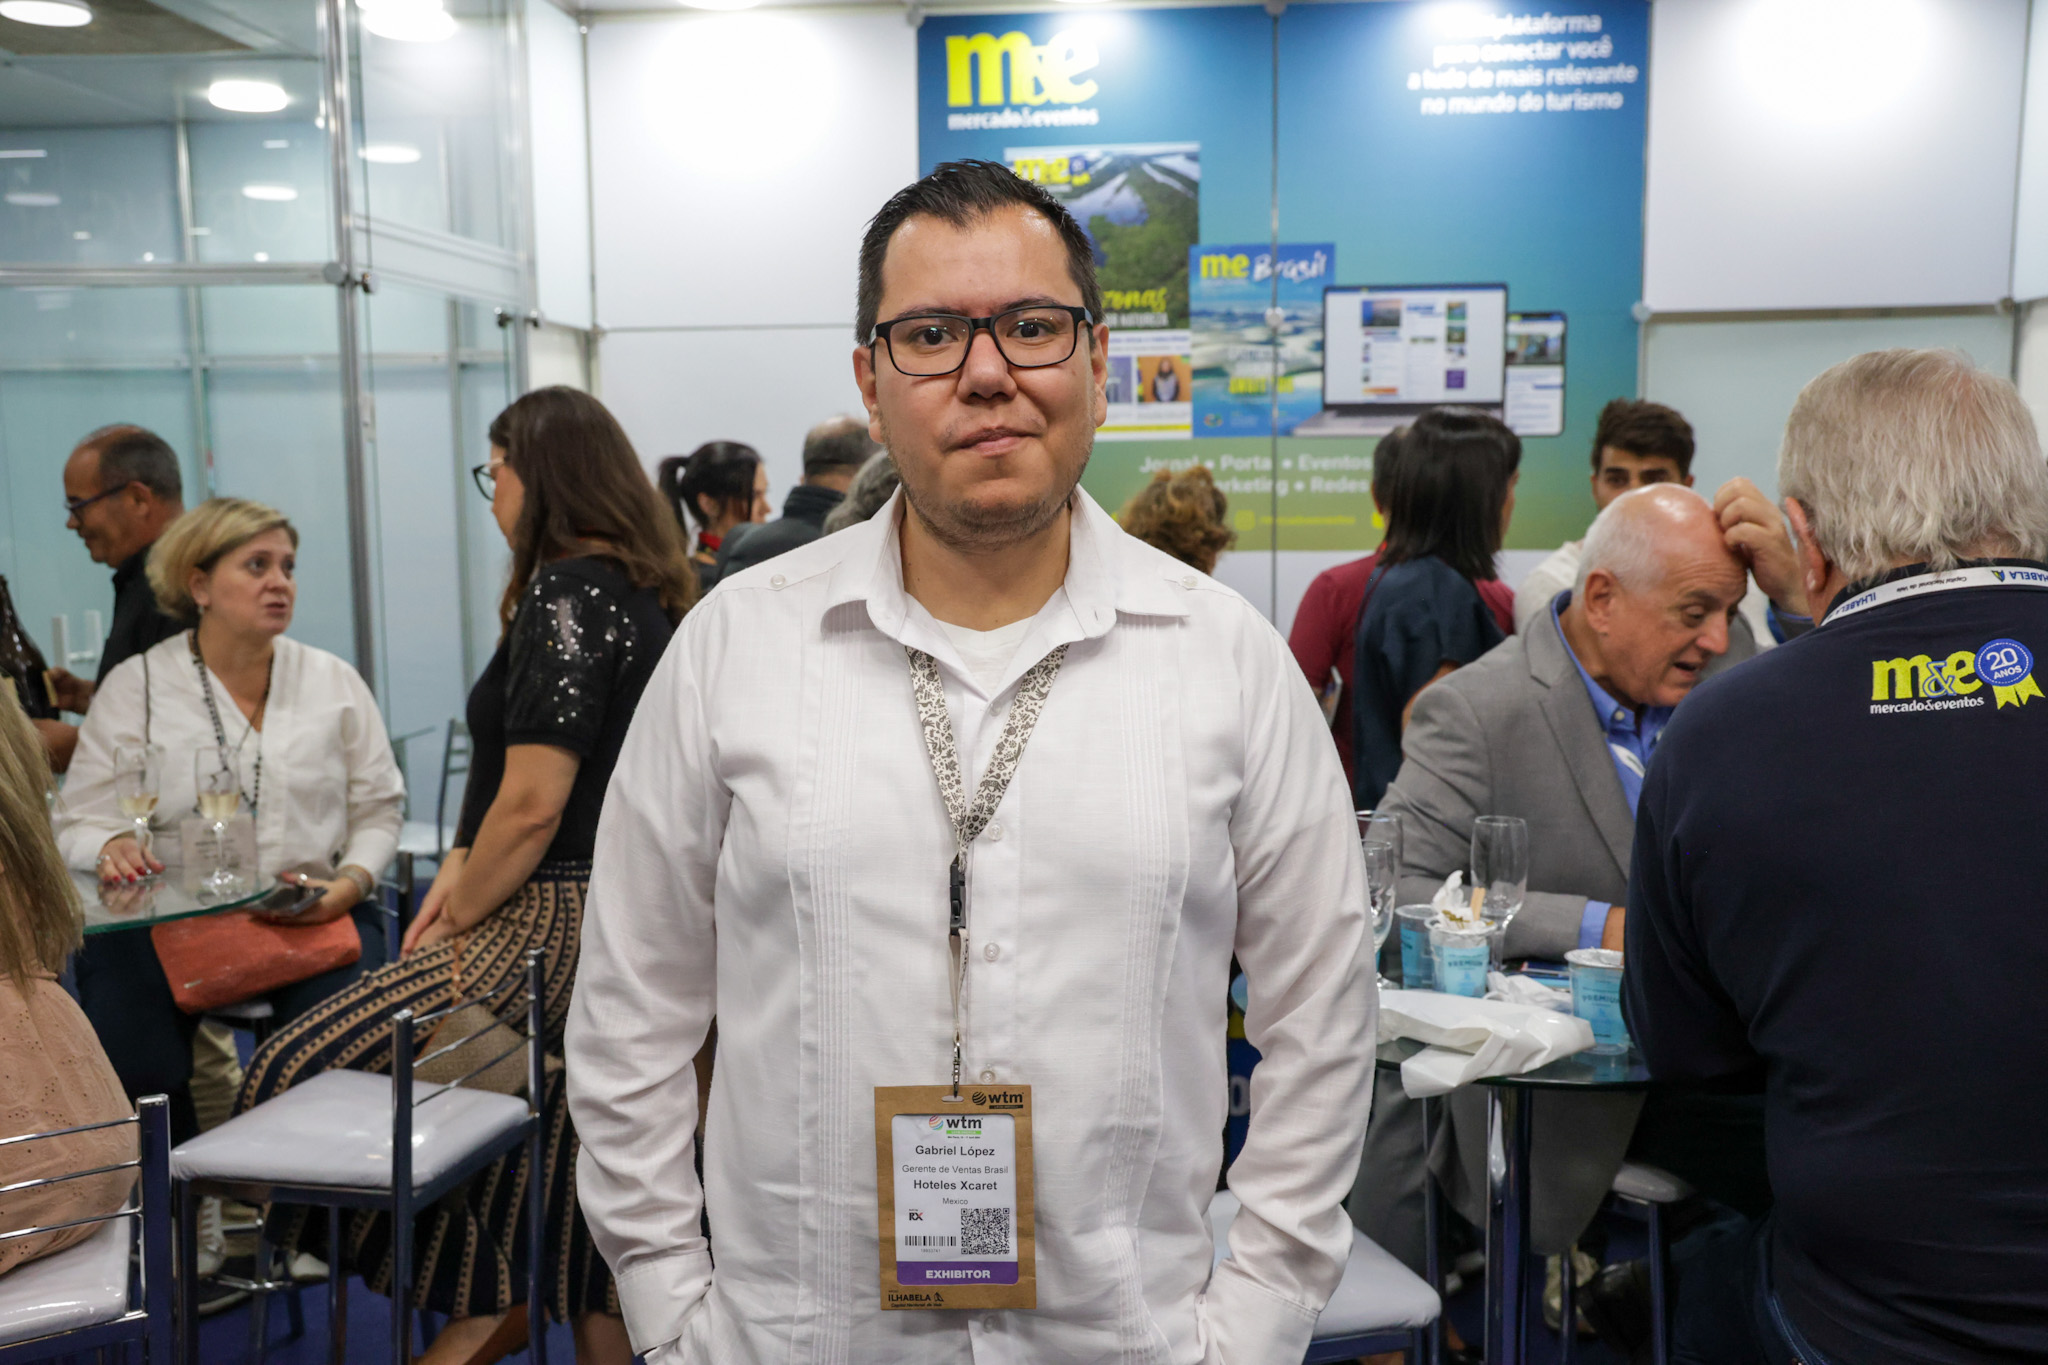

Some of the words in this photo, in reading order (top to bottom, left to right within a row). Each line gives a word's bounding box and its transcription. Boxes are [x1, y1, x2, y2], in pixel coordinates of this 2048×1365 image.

[1565, 34, 1613, 59] você
[946, 31, 1100, 107] m&e
[1496, 65, 1544, 87] mais
[1546, 63, 1639, 85] relevante
[1421, 97, 1447, 115] no
[1448, 92, 1517, 114] mundo
[1518, 91, 1544, 112] do
[1546, 89, 1624, 111] turismo
[1221, 455, 1273, 472] Porta
[1298, 454, 1372, 471] Eventos
[1213, 476, 1288, 497] arketing
[1310, 477, 1370, 493] Redes
[2009, 571, 2048, 582] HABELA
[1985, 648, 2019, 671] 20
[1871, 651, 1983, 701] m&e
[1993, 665, 2023, 680] ANOS
[1870, 696, 1985, 715] mercado&eventos
[988, 1091, 1024, 1104] wtm
[946, 1115, 982, 1129] wtm
[915, 1145, 957, 1156] Gabriel
[960, 1146, 995, 1158] López
[902, 1165, 937, 1173] Gerente
[938, 1165, 950, 1174] de
[952, 1166, 982, 1174] Ventas
[984, 1165, 1009, 1174] Brasil
[913, 1180, 957, 1190] Hoteles
[960, 1180, 997, 1191] Xcaret
[925, 1270, 991, 1279] EXHIBITOR
[888, 1294, 931, 1302] ILHABELA
